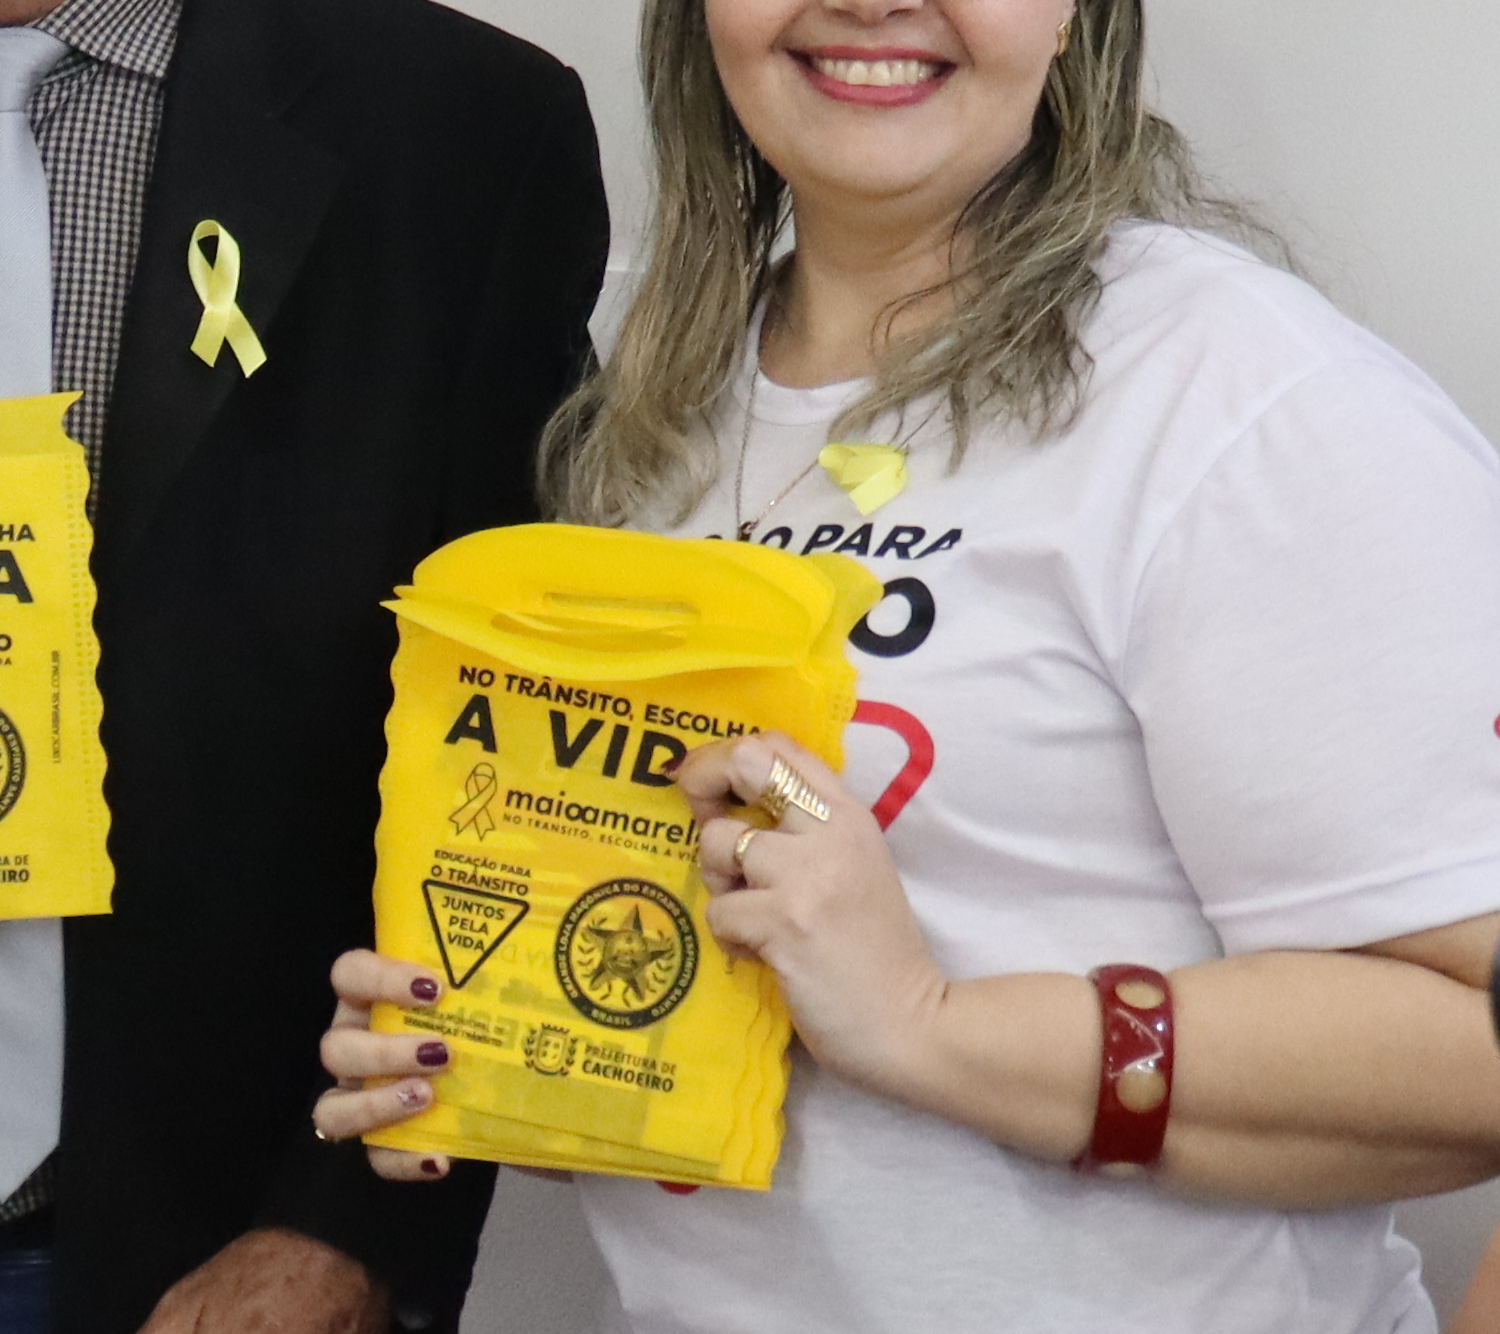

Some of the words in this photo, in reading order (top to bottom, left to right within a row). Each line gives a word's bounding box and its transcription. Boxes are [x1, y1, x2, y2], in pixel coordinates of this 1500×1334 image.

[800, 522, 963, 560] PARA
[458, 665, 496, 688] NO
[504, 673, 635, 721] TRÂNSITO,
[444, 693, 498, 754] A
[503, 812, 523, 825] NO
[600, 834, 659, 856] ESCOLHA
[663, 846, 673, 857] A
[14, 854, 29, 866] DE
[434, 849, 498, 872] EDUCAÇÃO
[431, 864, 443, 877] O
[448, 867, 529, 897] TRÂNSITO
[441, 895, 505, 921] JUNTOS
[449, 914, 489, 937] PELA
[581, 1058, 675, 1094] CACHOEIRO
[584, 1042, 658, 1071] PREFEITURA
[661, 1060, 678, 1076] DE
